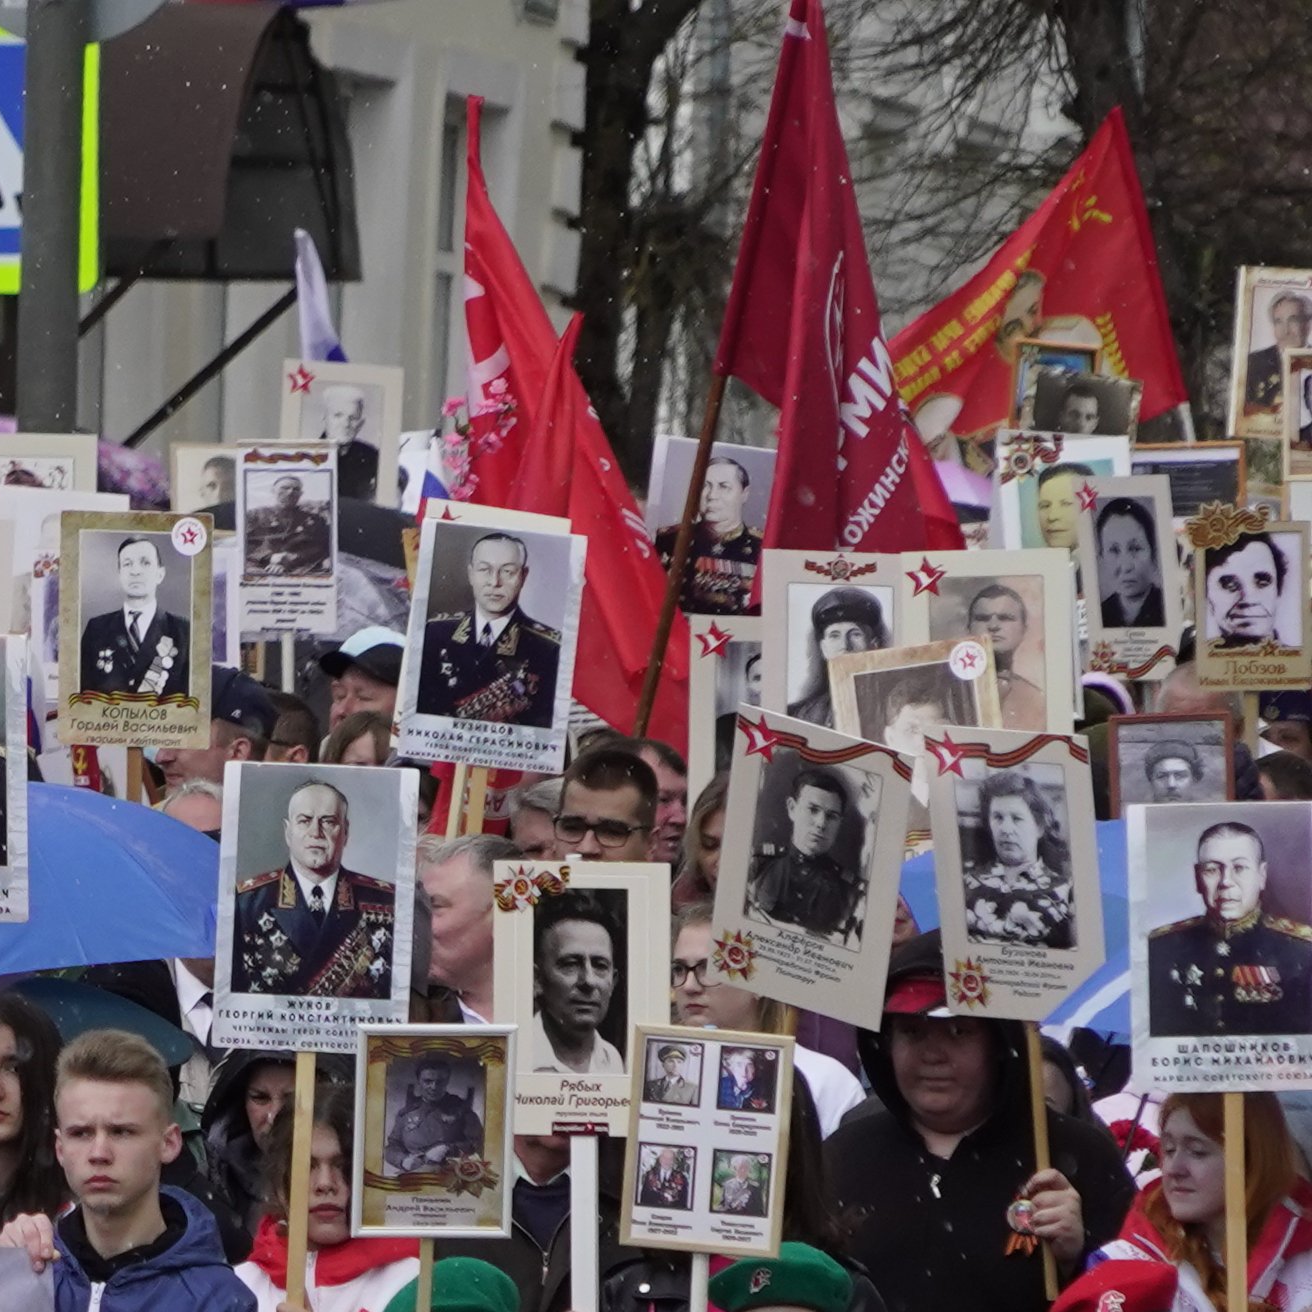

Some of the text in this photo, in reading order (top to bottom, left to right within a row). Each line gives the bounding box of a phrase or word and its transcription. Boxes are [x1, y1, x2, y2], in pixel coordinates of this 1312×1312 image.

[1225, 660, 1287, 675] Лобзов
[102, 706, 168, 720] КОПЫЛОВ
[70, 719, 198, 734] Гордей Васильевич
[453, 722, 514, 735] КУЗНЕЦОВ
[407, 728, 557, 752] НИКОЛАЙ ГЕРАСИМОВИЧ
[473, 756, 524, 769] СОВЕТСКОГО
[746, 931, 800, 954] Александр
[803, 949, 854, 970] Иванович
[287, 1000, 331, 1011] ЖУКОВ
[219, 1009, 403, 1024] ГЕОРГИЙ КОНСТАНТИНОВИЧ
[233, 1025, 287, 1034] ЧЕТЫРЕЖДЫ
[292, 1026, 321, 1035] ГЕРОЙ
[259, 1039, 296, 1047] МАРШАЛ
[1178, 1043, 1291, 1053] ШАПОШНИКОВ
[1152, 1057, 1203, 1067] БОРИС
[1203, 1073, 1272, 1082] СОВЕТСКОГО
[560, 1080, 602, 1092] Рябых
